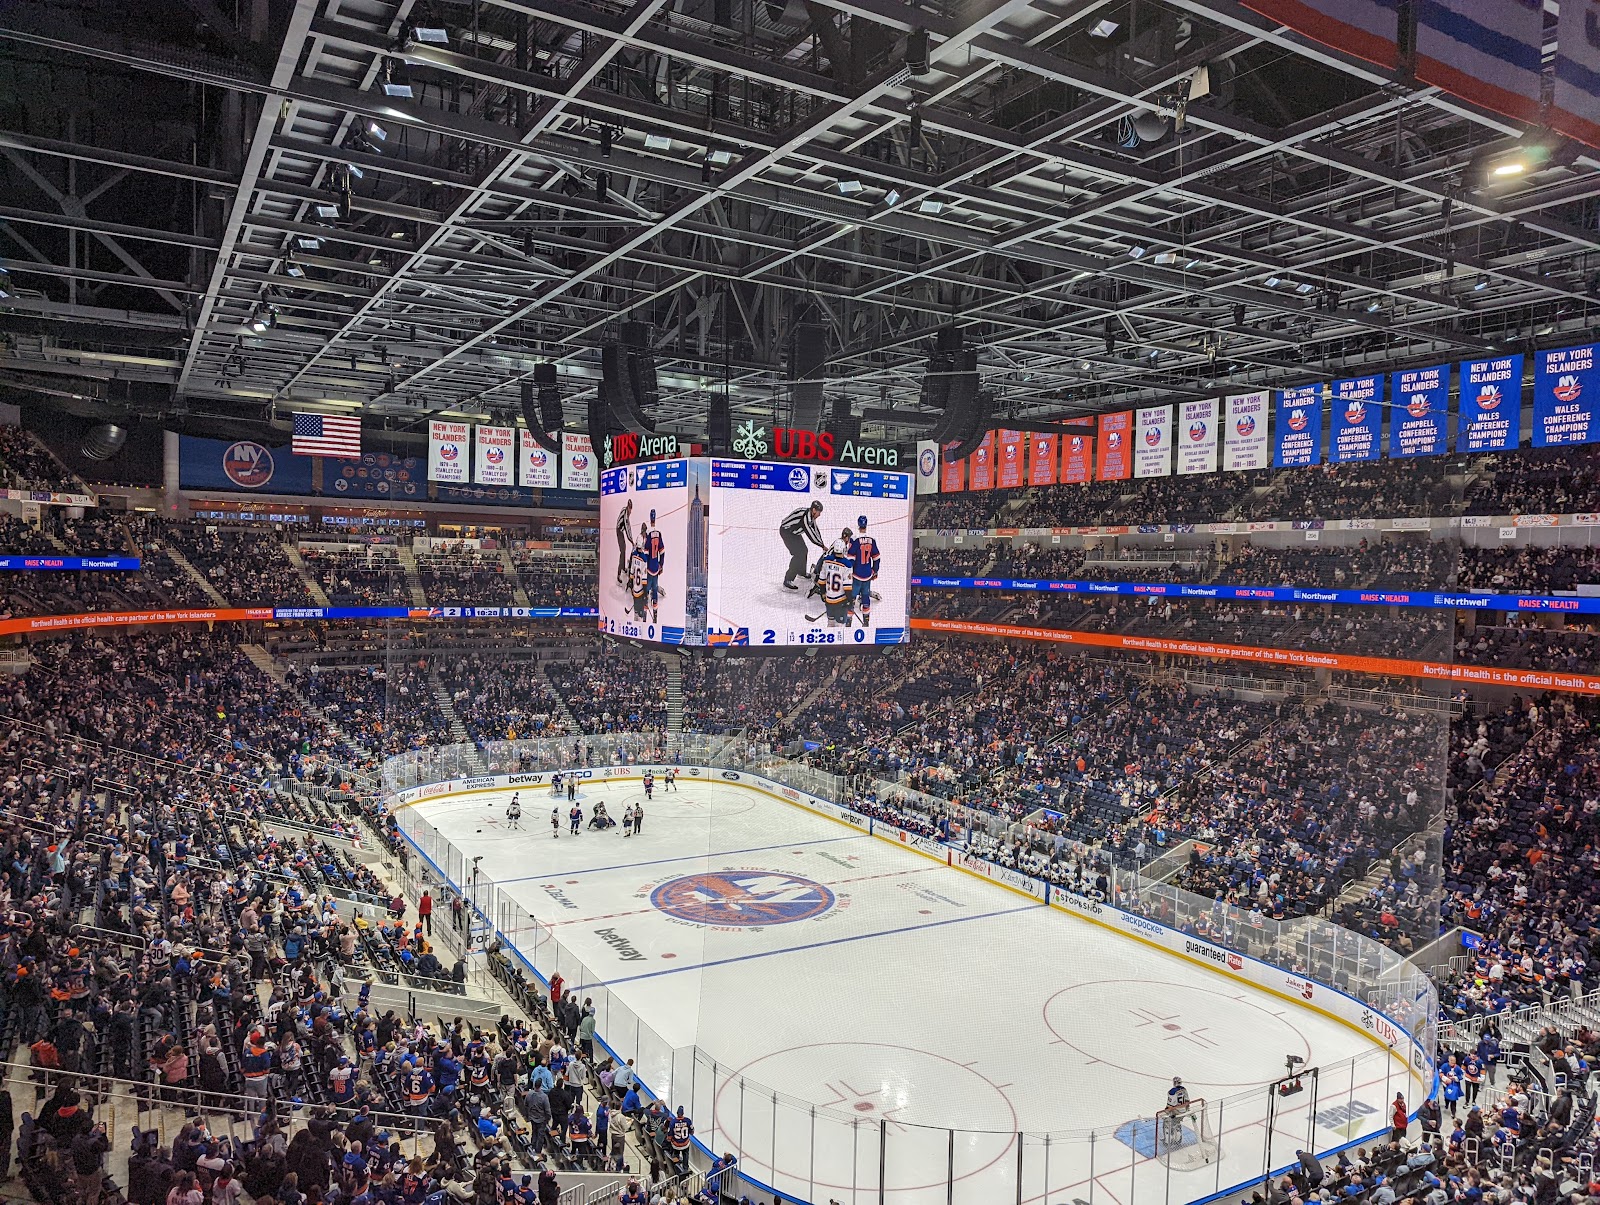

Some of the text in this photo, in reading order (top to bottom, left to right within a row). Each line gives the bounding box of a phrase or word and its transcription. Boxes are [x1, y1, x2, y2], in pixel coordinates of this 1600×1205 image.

[1546, 348, 1593, 363] NEW YORK
[1471, 359, 1511, 373] NEW YORK
[1546, 360, 1592, 374] ISLANDERS
[1402, 369, 1439, 382] NEW YORK
[1470, 370, 1511, 383] ISLANDERS
[1340, 379, 1374, 390] NEW YORK
[1401, 380, 1438, 392] ISLANDERS
[1247, 396, 1260, 404] YORK
[1340, 389, 1374, 400] ISLANDERS
[1199, 403, 1211, 411] YORK
[1284, 397, 1314, 408] ISLANDERS
[1232, 404, 1261, 414] ISLANDERS
[1555, 404, 1579, 414] WALES
[1186, 411, 1211, 420] ISLANDERS
[1478, 412, 1499, 421] WALES
[1544, 412, 1590, 425] CONFERENCE
[1142, 417, 1166, 426] ISLANDERS
[1403, 420, 1434, 430] CAMPBELL
[433, 423, 466, 434] NEW YORK
[480, 427, 511, 437] NEW YORK
[1340, 426, 1370, 435] CAMPBELL
[1399, 428, 1437, 438] CONFERENCE
[1544, 423, 1588, 434] CHAMPIONS
[432, 432, 466, 443] ISLANDERS
[566, 435, 592, 444] NEW YOR
[1284, 433, 1311, 442] CAMPBELL
[1338, 434, 1372, 443] CONFERENCE
[1468, 430, 1506, 440] CHAMPIONS
[479, 436, 511, 446] ISLANDERS
[773, 427, 898, 466] UBS Arena
[1282, 440, 1313, 449] CONFERENCE
[1401, 436, 1435, 447] CHAMPIONS
[613, 432, 676, 462] UBS Arena
[1282, 448, 1312, 457] CHAMPIONS
[1338, 442, 1370, 452] CHAMPIONS
[860, 544, 872, 564] 17
[826, 573, 841, 590] 46
[1444, 598, 1487, 607] Northwell
[1519, 600, 1579, 609] RAISE HEALTH
[129, 614, 148, 622] partner
[610, 620, 615, 632] 2
[648, 625, 655, 639] 0
[763, 629, 775, 644] 2
[854, 629, 865, 642] 0
[799, 633, 835, 644] 18:28
[1123, 638, 1145, 646] Northwell
[1179, 643, 1197, 651] official
[1198, 644, 1216, 653] health
[1231, 648, 1253, 658] partner
[1289, 653, 1304, 661] York
[1306, 656, 1337, 665] Islanders
[1424, 665, 1461, 677] Northwell
[1464, 669, 1490, 679] Health
[1493, 671, 1501, 680] is
[1504, 671, 1517, 681] the
[1520, 674, 1552, 685] official
[1555, 677, 1585, 688] health
[508, 774, 543, 785] betway
[424, 784, 445, 796] Coca-Cola
[841, 811, 862, 825] verizon
[545, 888, 579, 909] DELMAR
[1121, 914, 1163, 935] Jackpocket
[594, 927, 647, 961] betway
[151, 949, 164, 960] 30
[1186, 940, 1242, 966] guaranteed Rate
[1376, 1017, 1397, 1044] UBS
[472, 1068, 483, 1079] 27
[334, 1081, 345, 1094] 15
[412, 1081, 420, 1094] 6
[674, 1127, 688, 1140] 50
